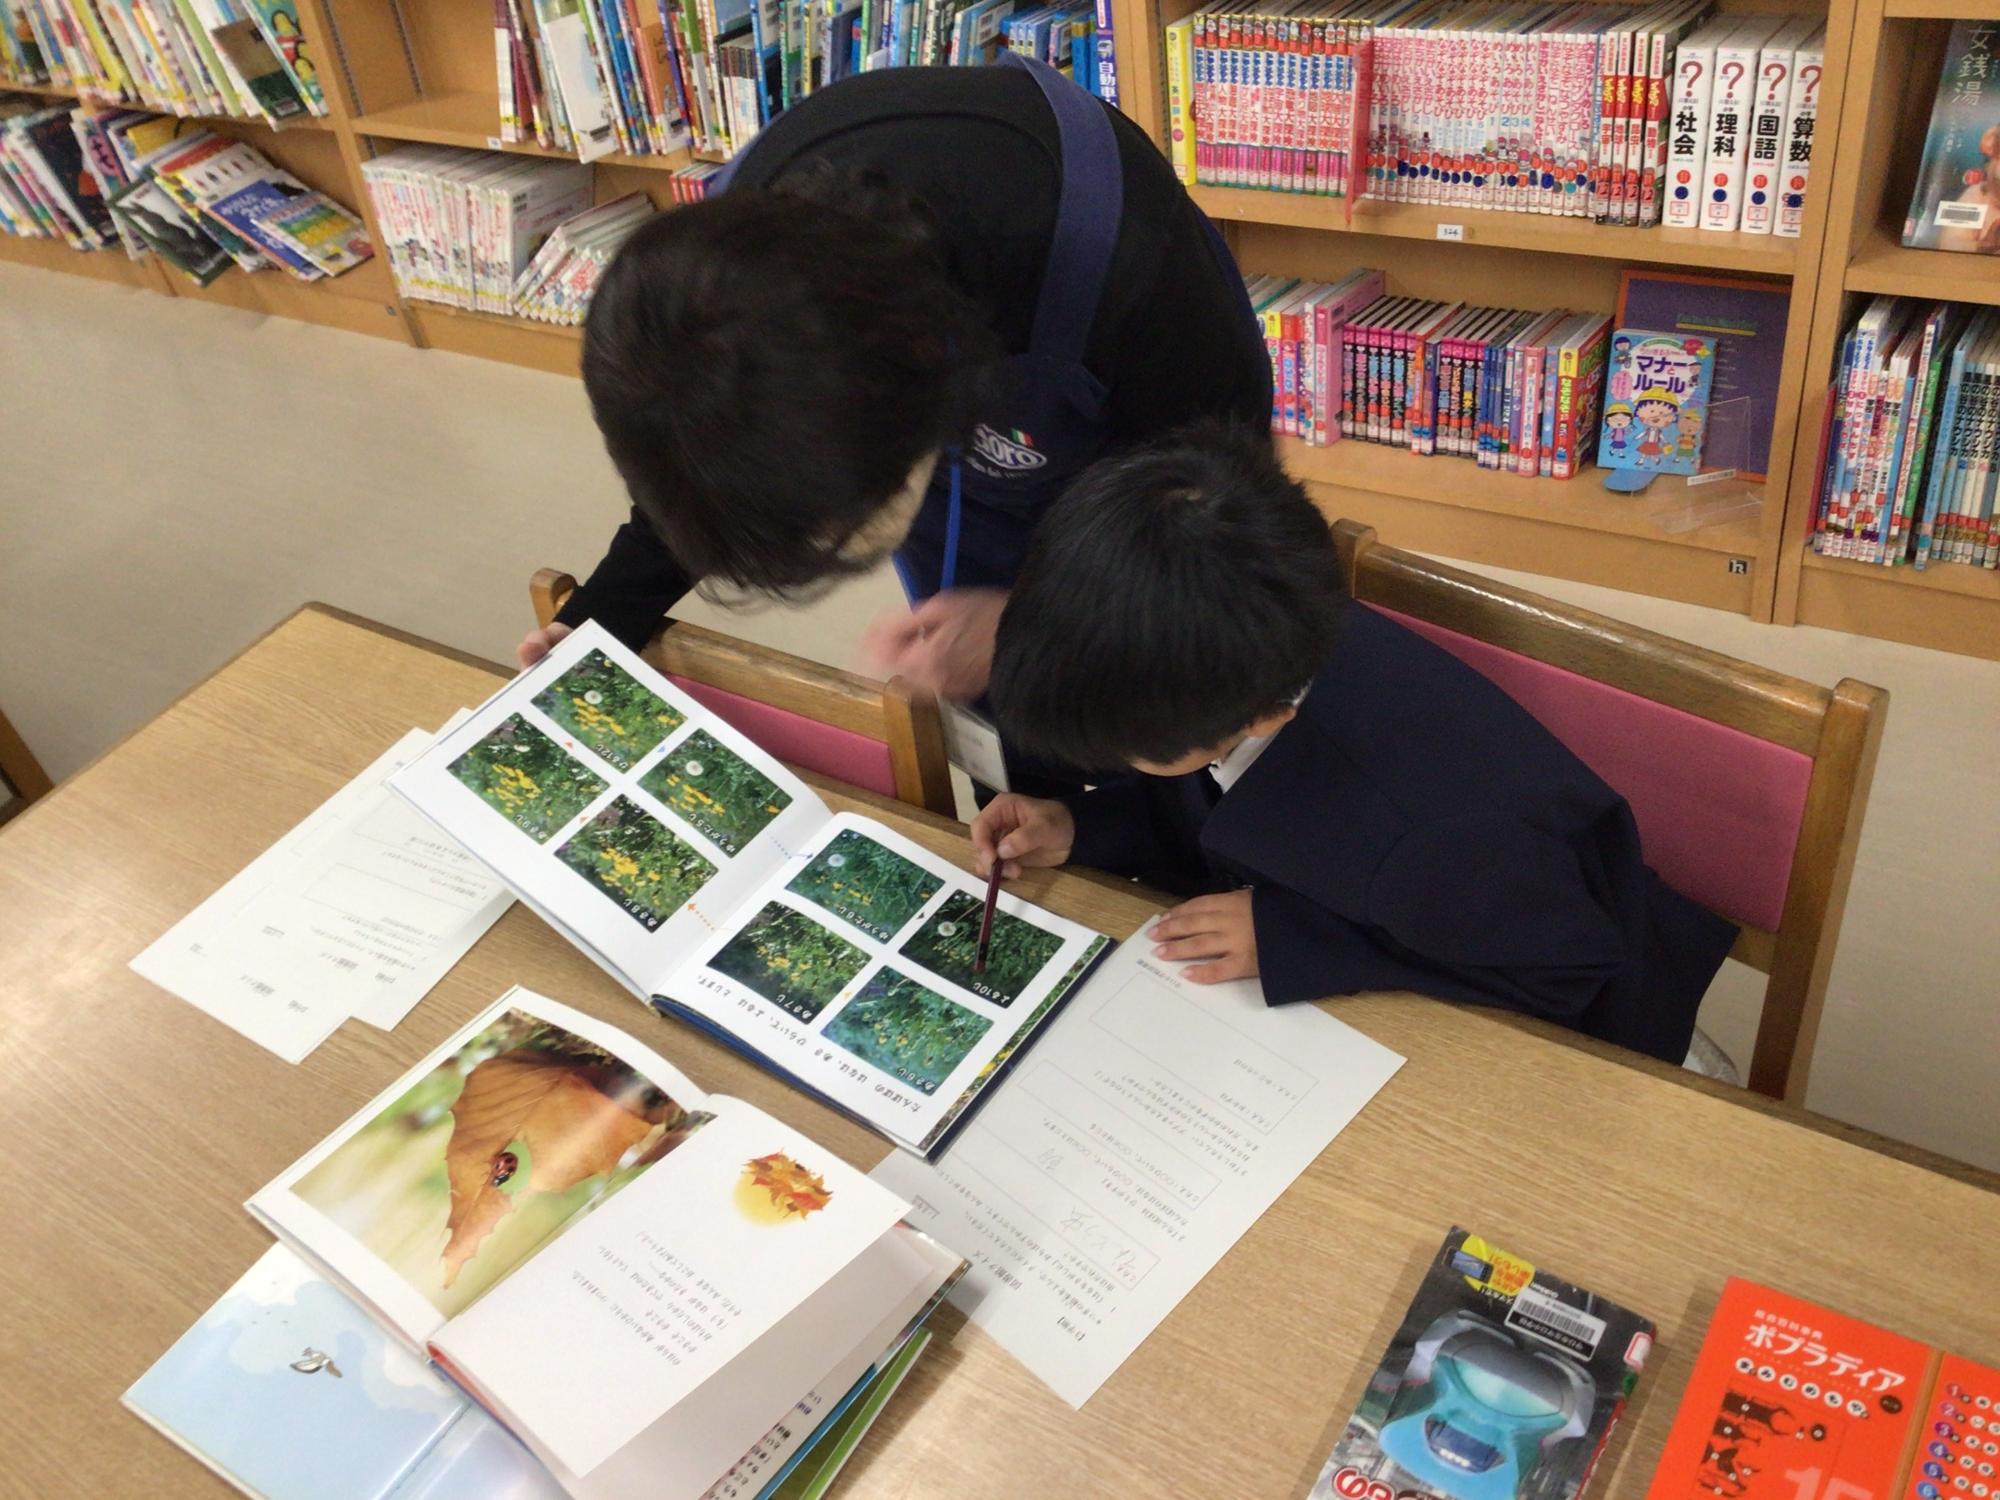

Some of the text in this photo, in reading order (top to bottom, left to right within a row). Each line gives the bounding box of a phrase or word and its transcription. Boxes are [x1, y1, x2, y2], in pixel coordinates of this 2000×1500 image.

[1501, 116, 1511, 126] 2
[1674, 111, 1697, 155] 社会
[1713, 114, 1738, 158] 理科
[1754, 115, 1779, 160] 国語
[1789, 117, 1816, 162] 算数
[1633, 374, 1685, 394] ルール
[1636, 355, 1687, 373] マナー
[694, 971, 921, 1116] たんぽぽの はなは、 あさ ひらいて、 よるは とじます。
[1744, 1323, 1906, 1392] ポプラディア
